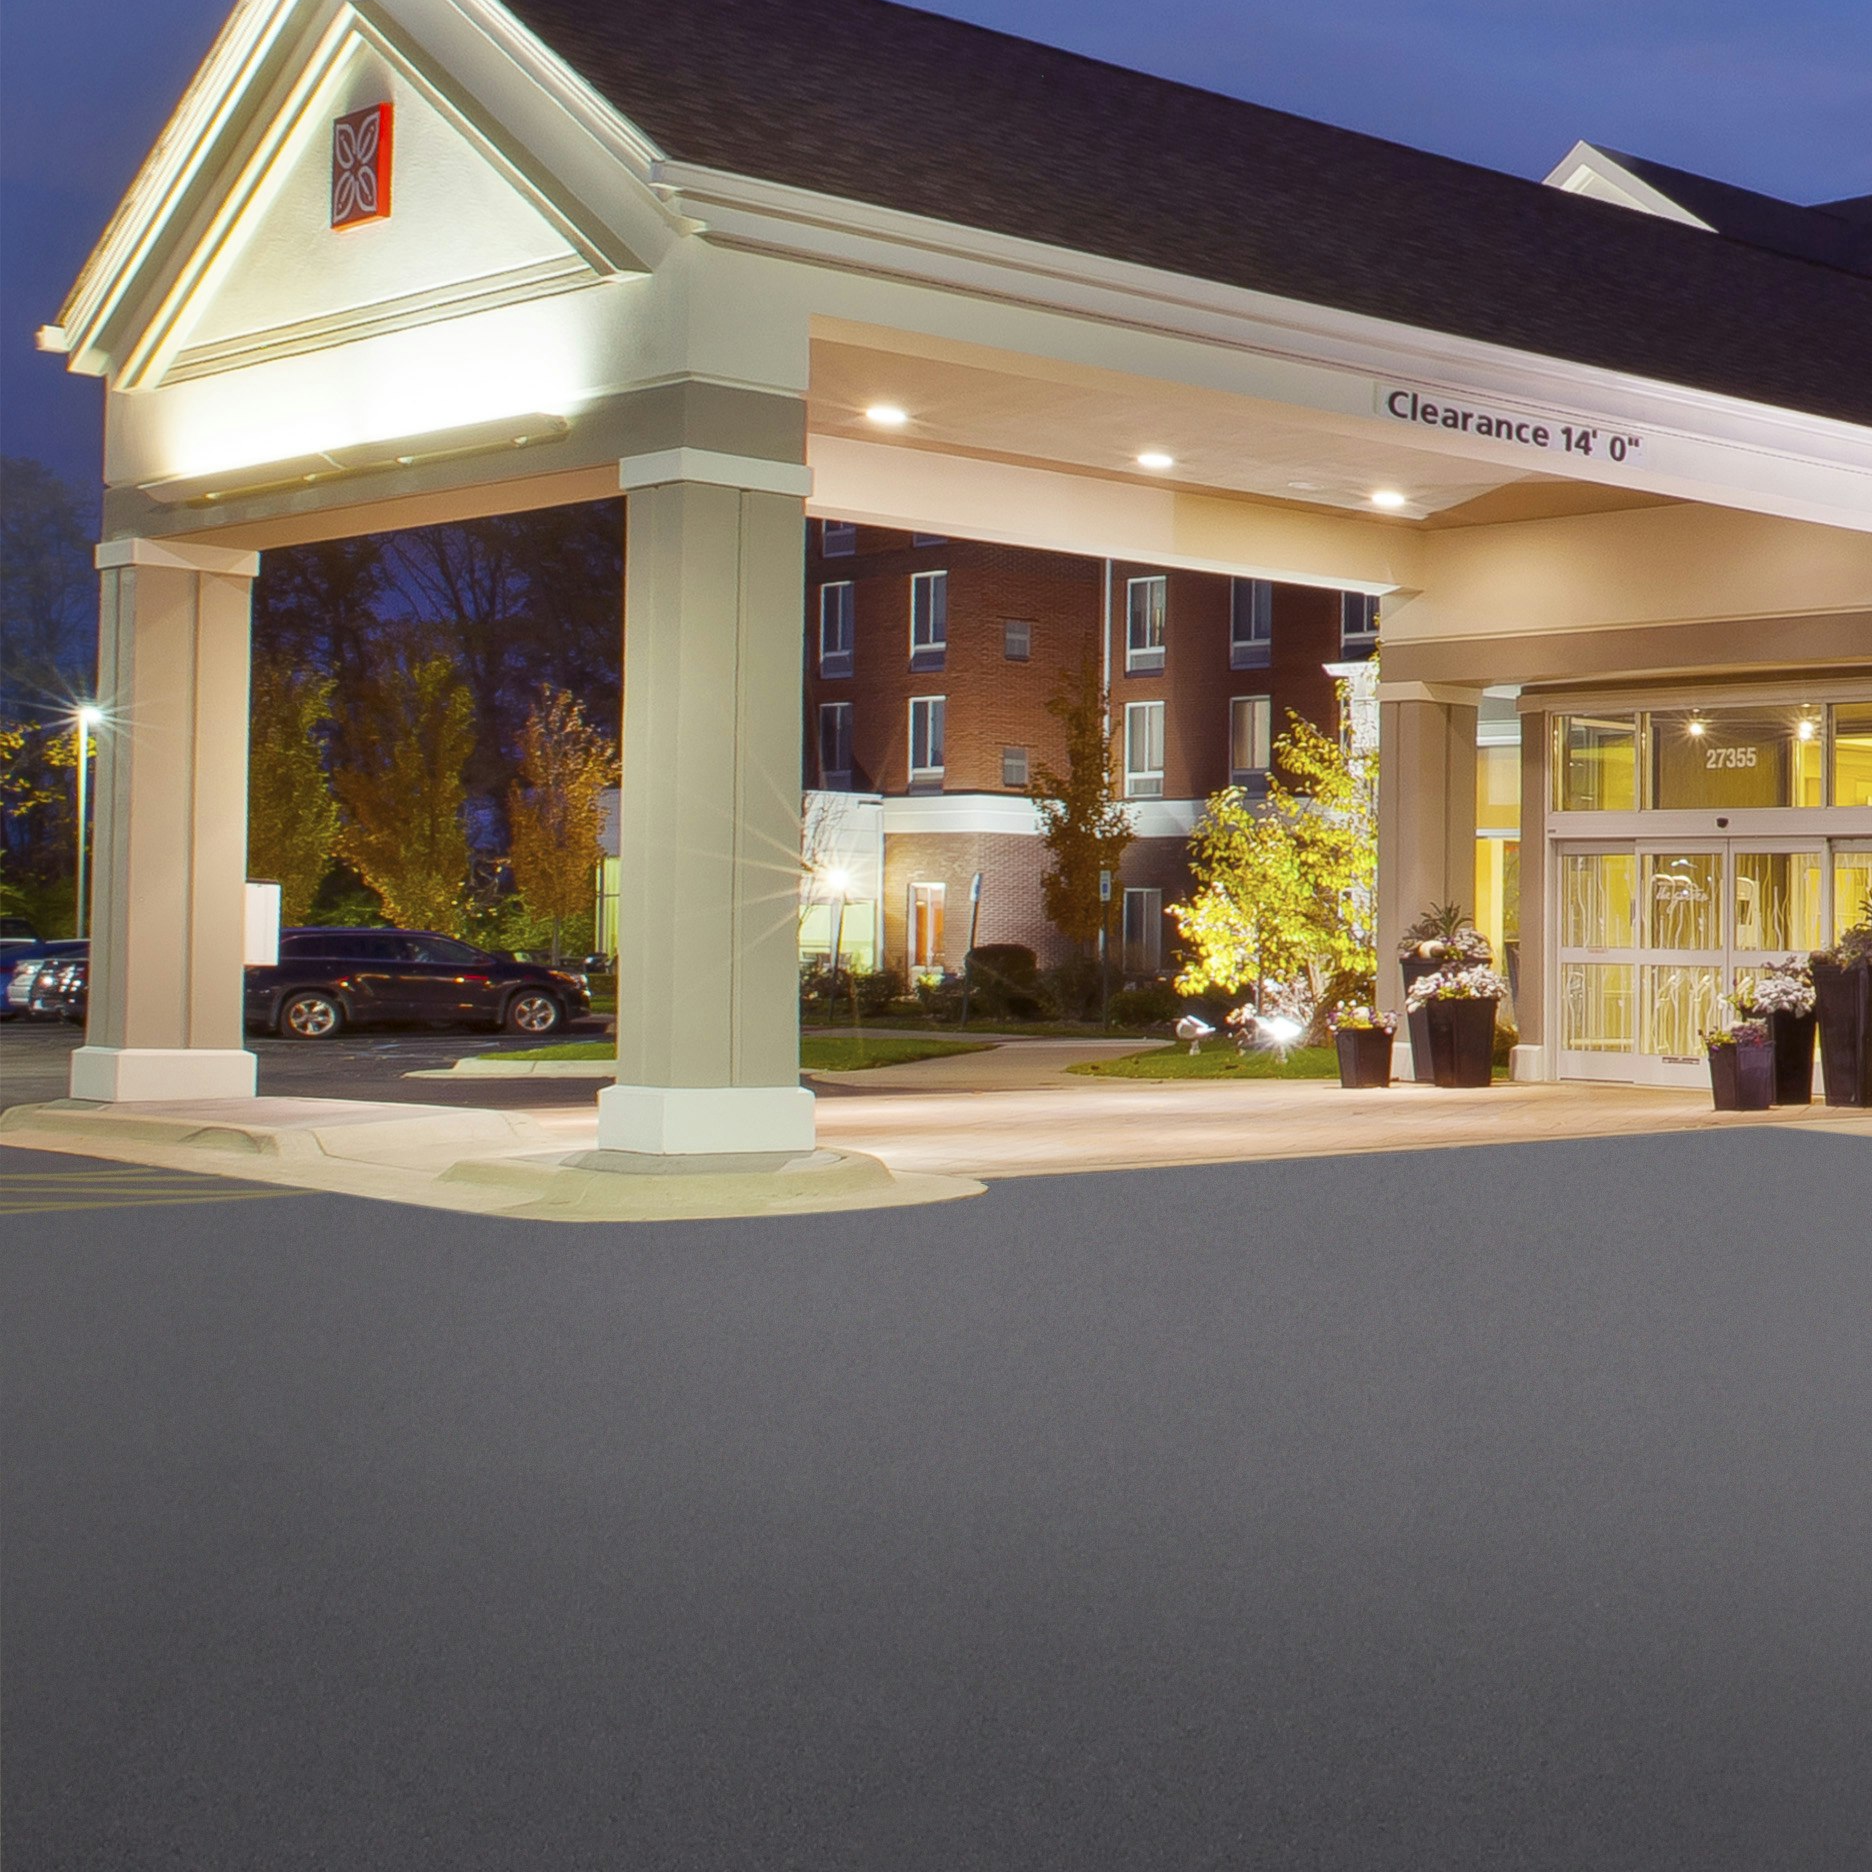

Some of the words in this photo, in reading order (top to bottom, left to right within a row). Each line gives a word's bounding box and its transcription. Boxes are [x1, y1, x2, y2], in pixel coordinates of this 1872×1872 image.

[1387, 390, 1550, 447] Clearance
[1560, 427, 1599, 456] 14'
[1609, 435, 1640, 462] 0"
[1706, 747, 1757, 769] 27355
